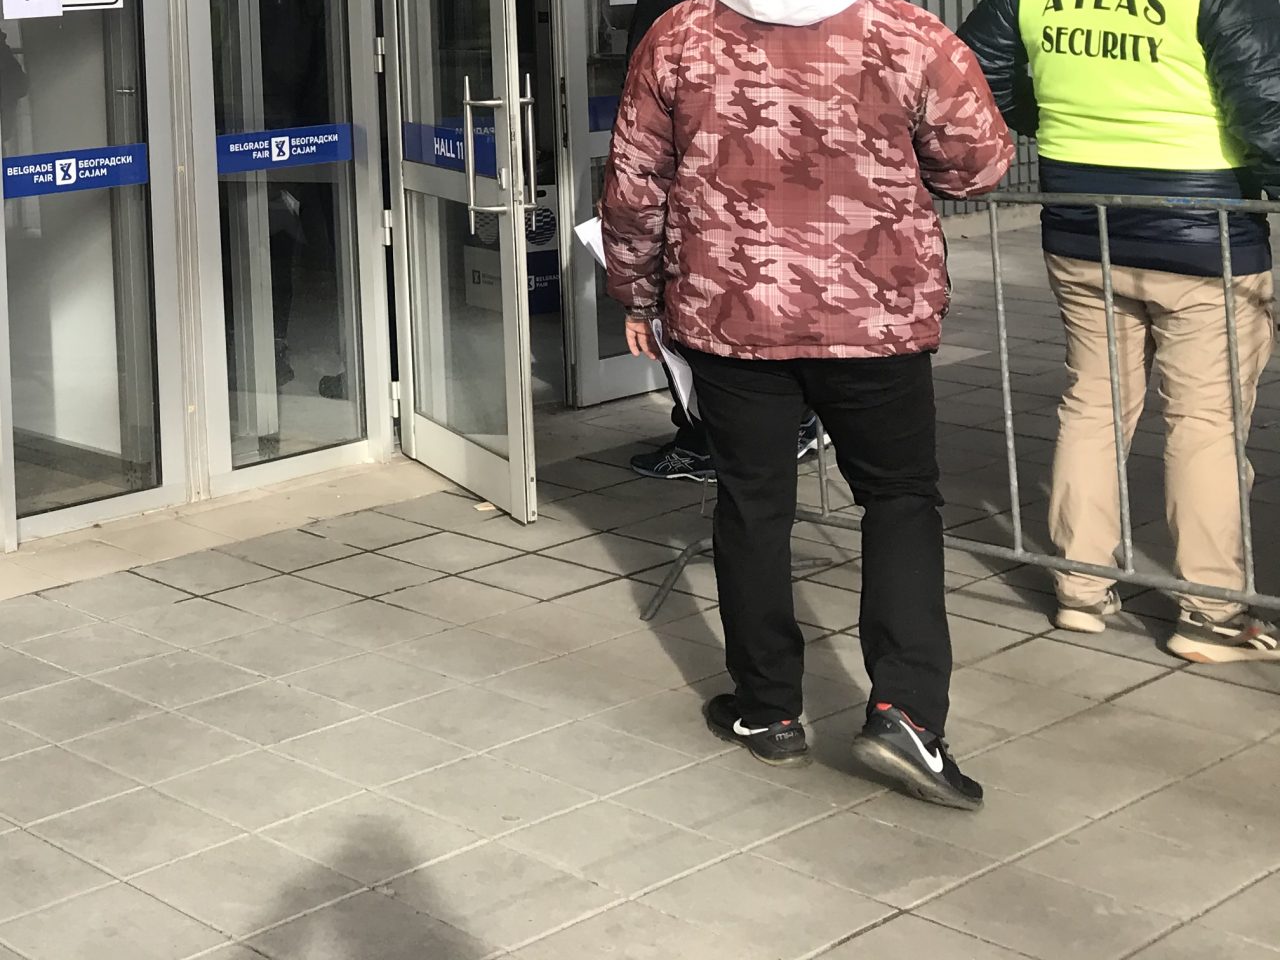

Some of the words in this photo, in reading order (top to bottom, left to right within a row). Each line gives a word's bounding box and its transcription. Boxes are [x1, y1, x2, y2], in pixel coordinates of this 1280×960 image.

[1041, 25, 1163, 63] SECURITY
[229, 140, 270, 152] BELGRADE
[291, 134, 338, 146] БЕОГРАДСКИ
[291, 145, 317, 155] САЈАМ
[433, 137, 456, 158] HALL
[252, 150, 270, 159] FAIR
[78, 155, 133, 169] БЕОГРАДСКИ
[7, 163, 53, 176] BELGRADE
[78, 168, 108, 178] САЈАМ
[33, 174, 53, 183] FAIR
